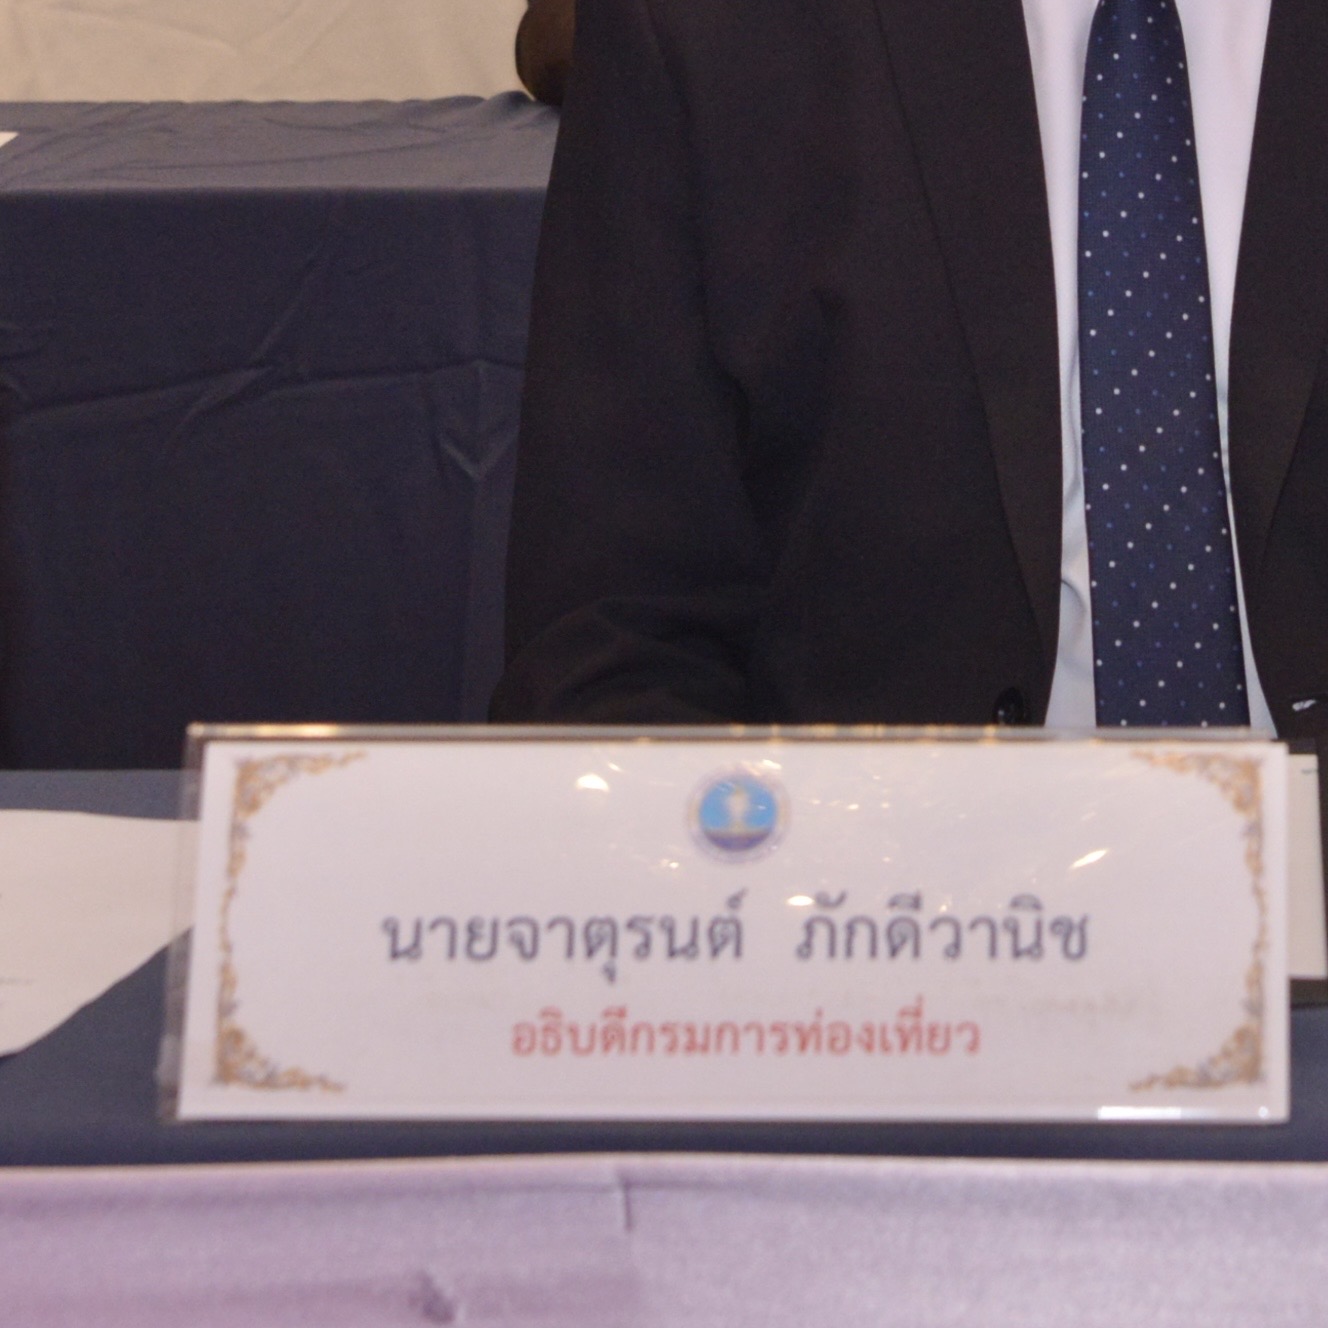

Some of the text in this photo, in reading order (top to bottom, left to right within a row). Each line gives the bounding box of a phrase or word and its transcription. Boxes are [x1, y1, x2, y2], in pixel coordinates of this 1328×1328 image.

[381, 888, 1089, 985] นายจาตุรนต์ ภักดีวานิช
[511, 998, 981, 1058] อธิบดีกรมการท่องเที่ยว
